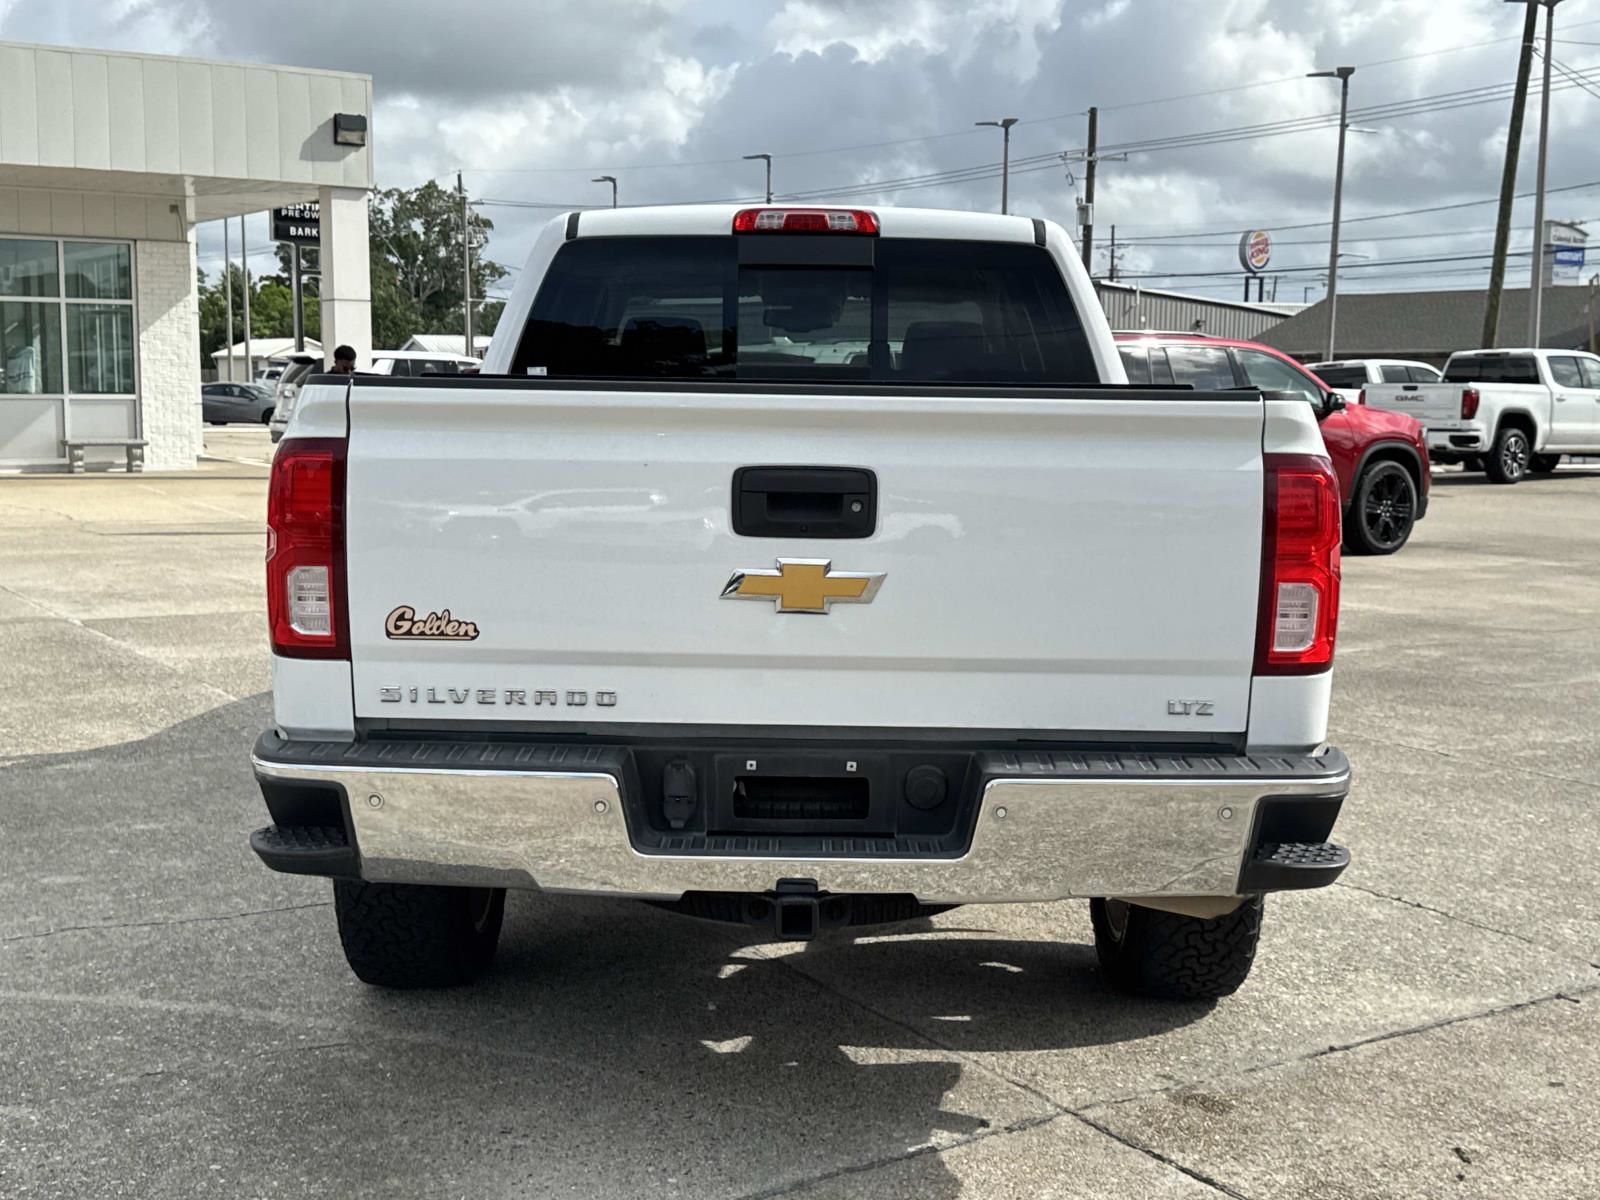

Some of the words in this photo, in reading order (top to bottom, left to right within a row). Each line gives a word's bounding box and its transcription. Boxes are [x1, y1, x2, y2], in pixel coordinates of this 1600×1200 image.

[1250, 246, 1270, 259] KING
[1395, 394, 1425, 402] GMC
[385, 605, 480, 640] Golden
[380, 686, 618, 707] SILVERADO
[1167, 699, 1214, 716] LTZ
